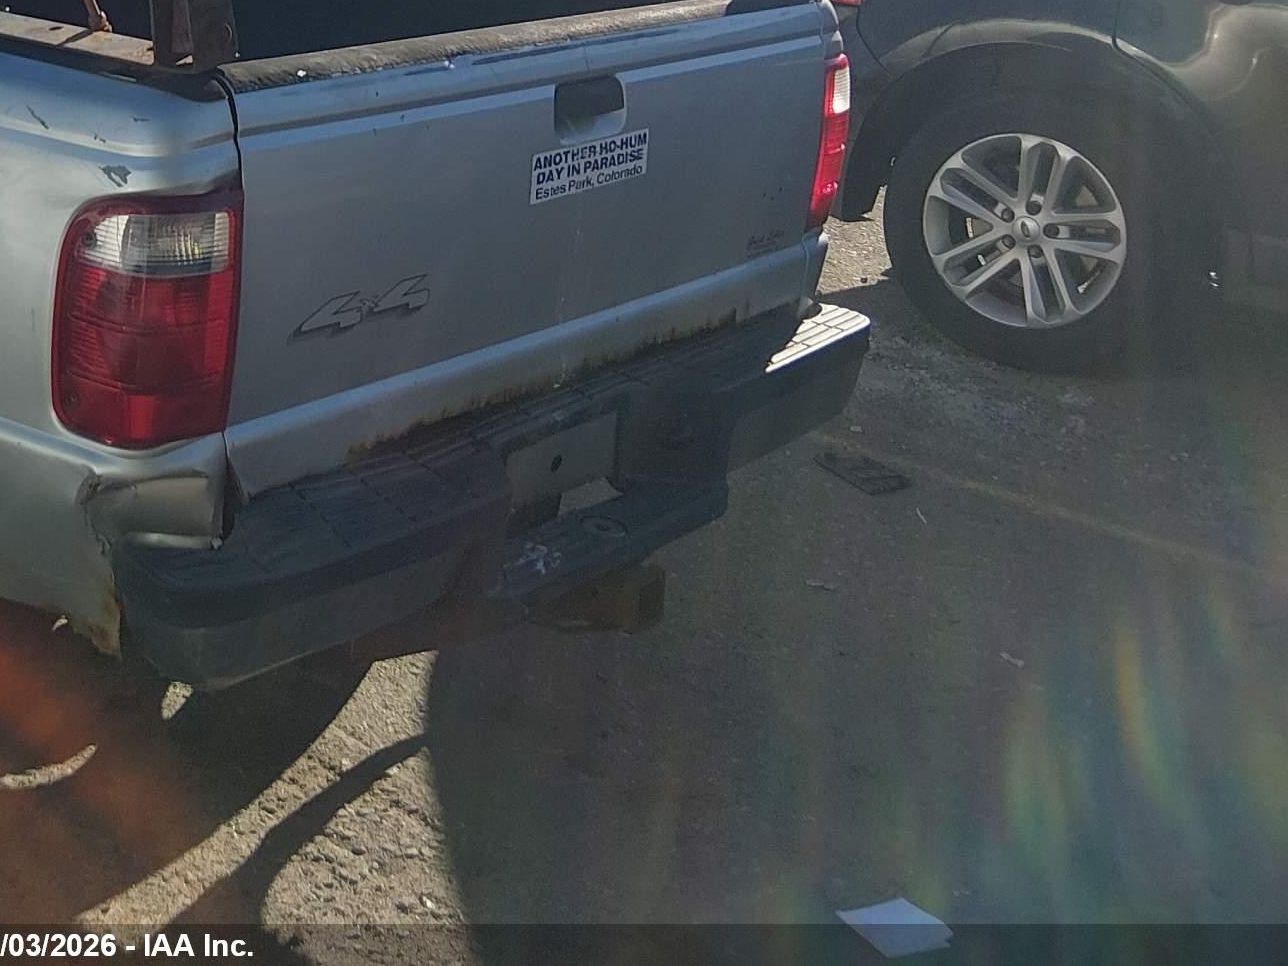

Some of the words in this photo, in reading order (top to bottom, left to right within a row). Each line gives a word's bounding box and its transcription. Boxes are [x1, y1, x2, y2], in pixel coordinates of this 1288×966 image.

[533, 145, 597, 171] ANOTHER
[598, 133, 647, 155] HO-HUM
[536, 167, 563, 185] DAY
[566, 164, 581, 178] IN
[583, 148, 644, 174] PARADISE
[535, 182, 566, 200] Estes
[568, 178, 595, 193] Park,
[596, 164, 643, 185] Colorado
